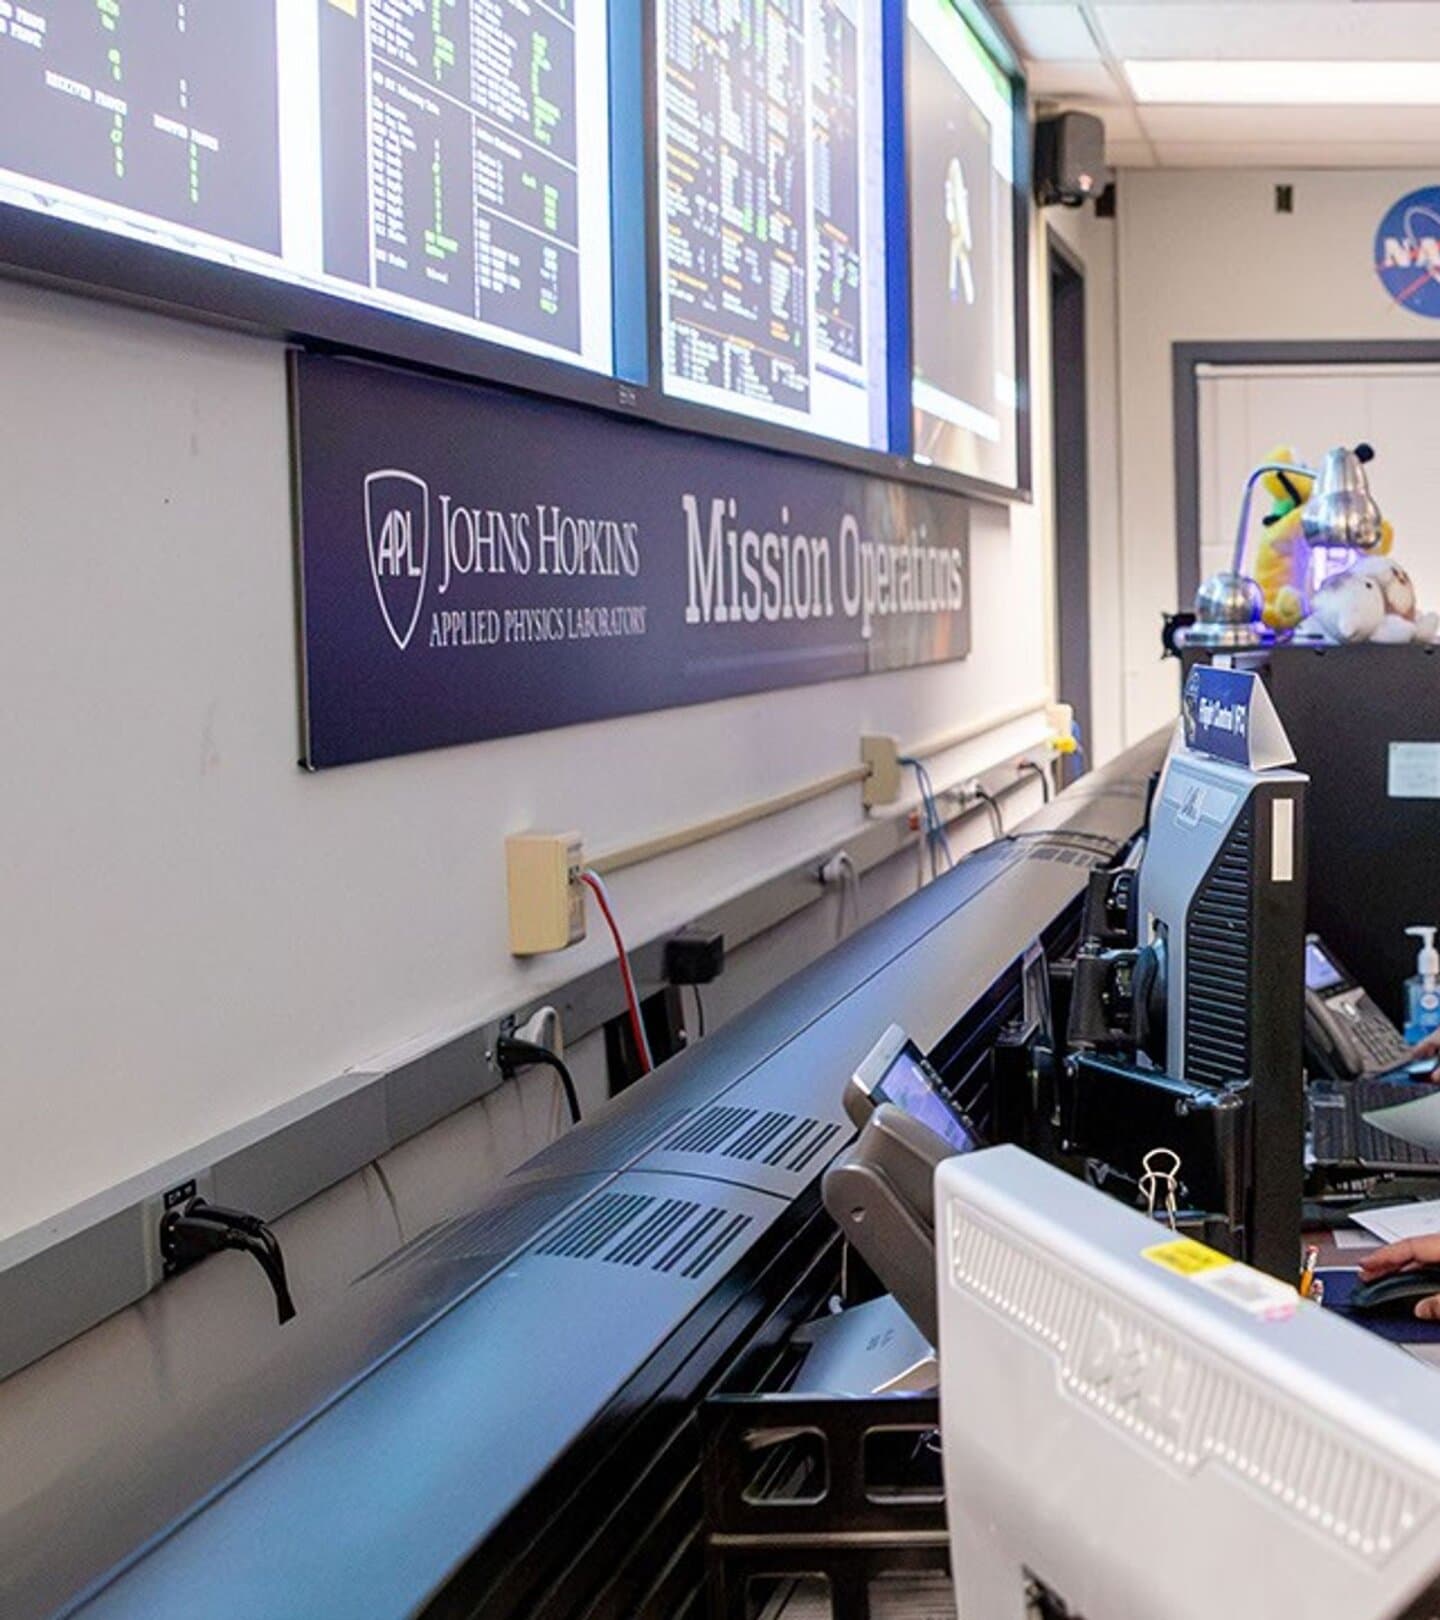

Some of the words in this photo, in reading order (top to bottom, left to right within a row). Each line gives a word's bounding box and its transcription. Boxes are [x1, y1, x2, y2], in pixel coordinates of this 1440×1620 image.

[378, 510, 421, 576] APL
[439, 495, 530, 593] JOHNS
[536, 505, 640, 577] HOPKINS
[682, 494, 833, 623] Mission
[840, 514, 963, 638] Operations
[429, 610, 499, 647] APPLIED
[504, 606, 564, 643] PHYSICS
[567, 605, 648, 638] LABORATORY
